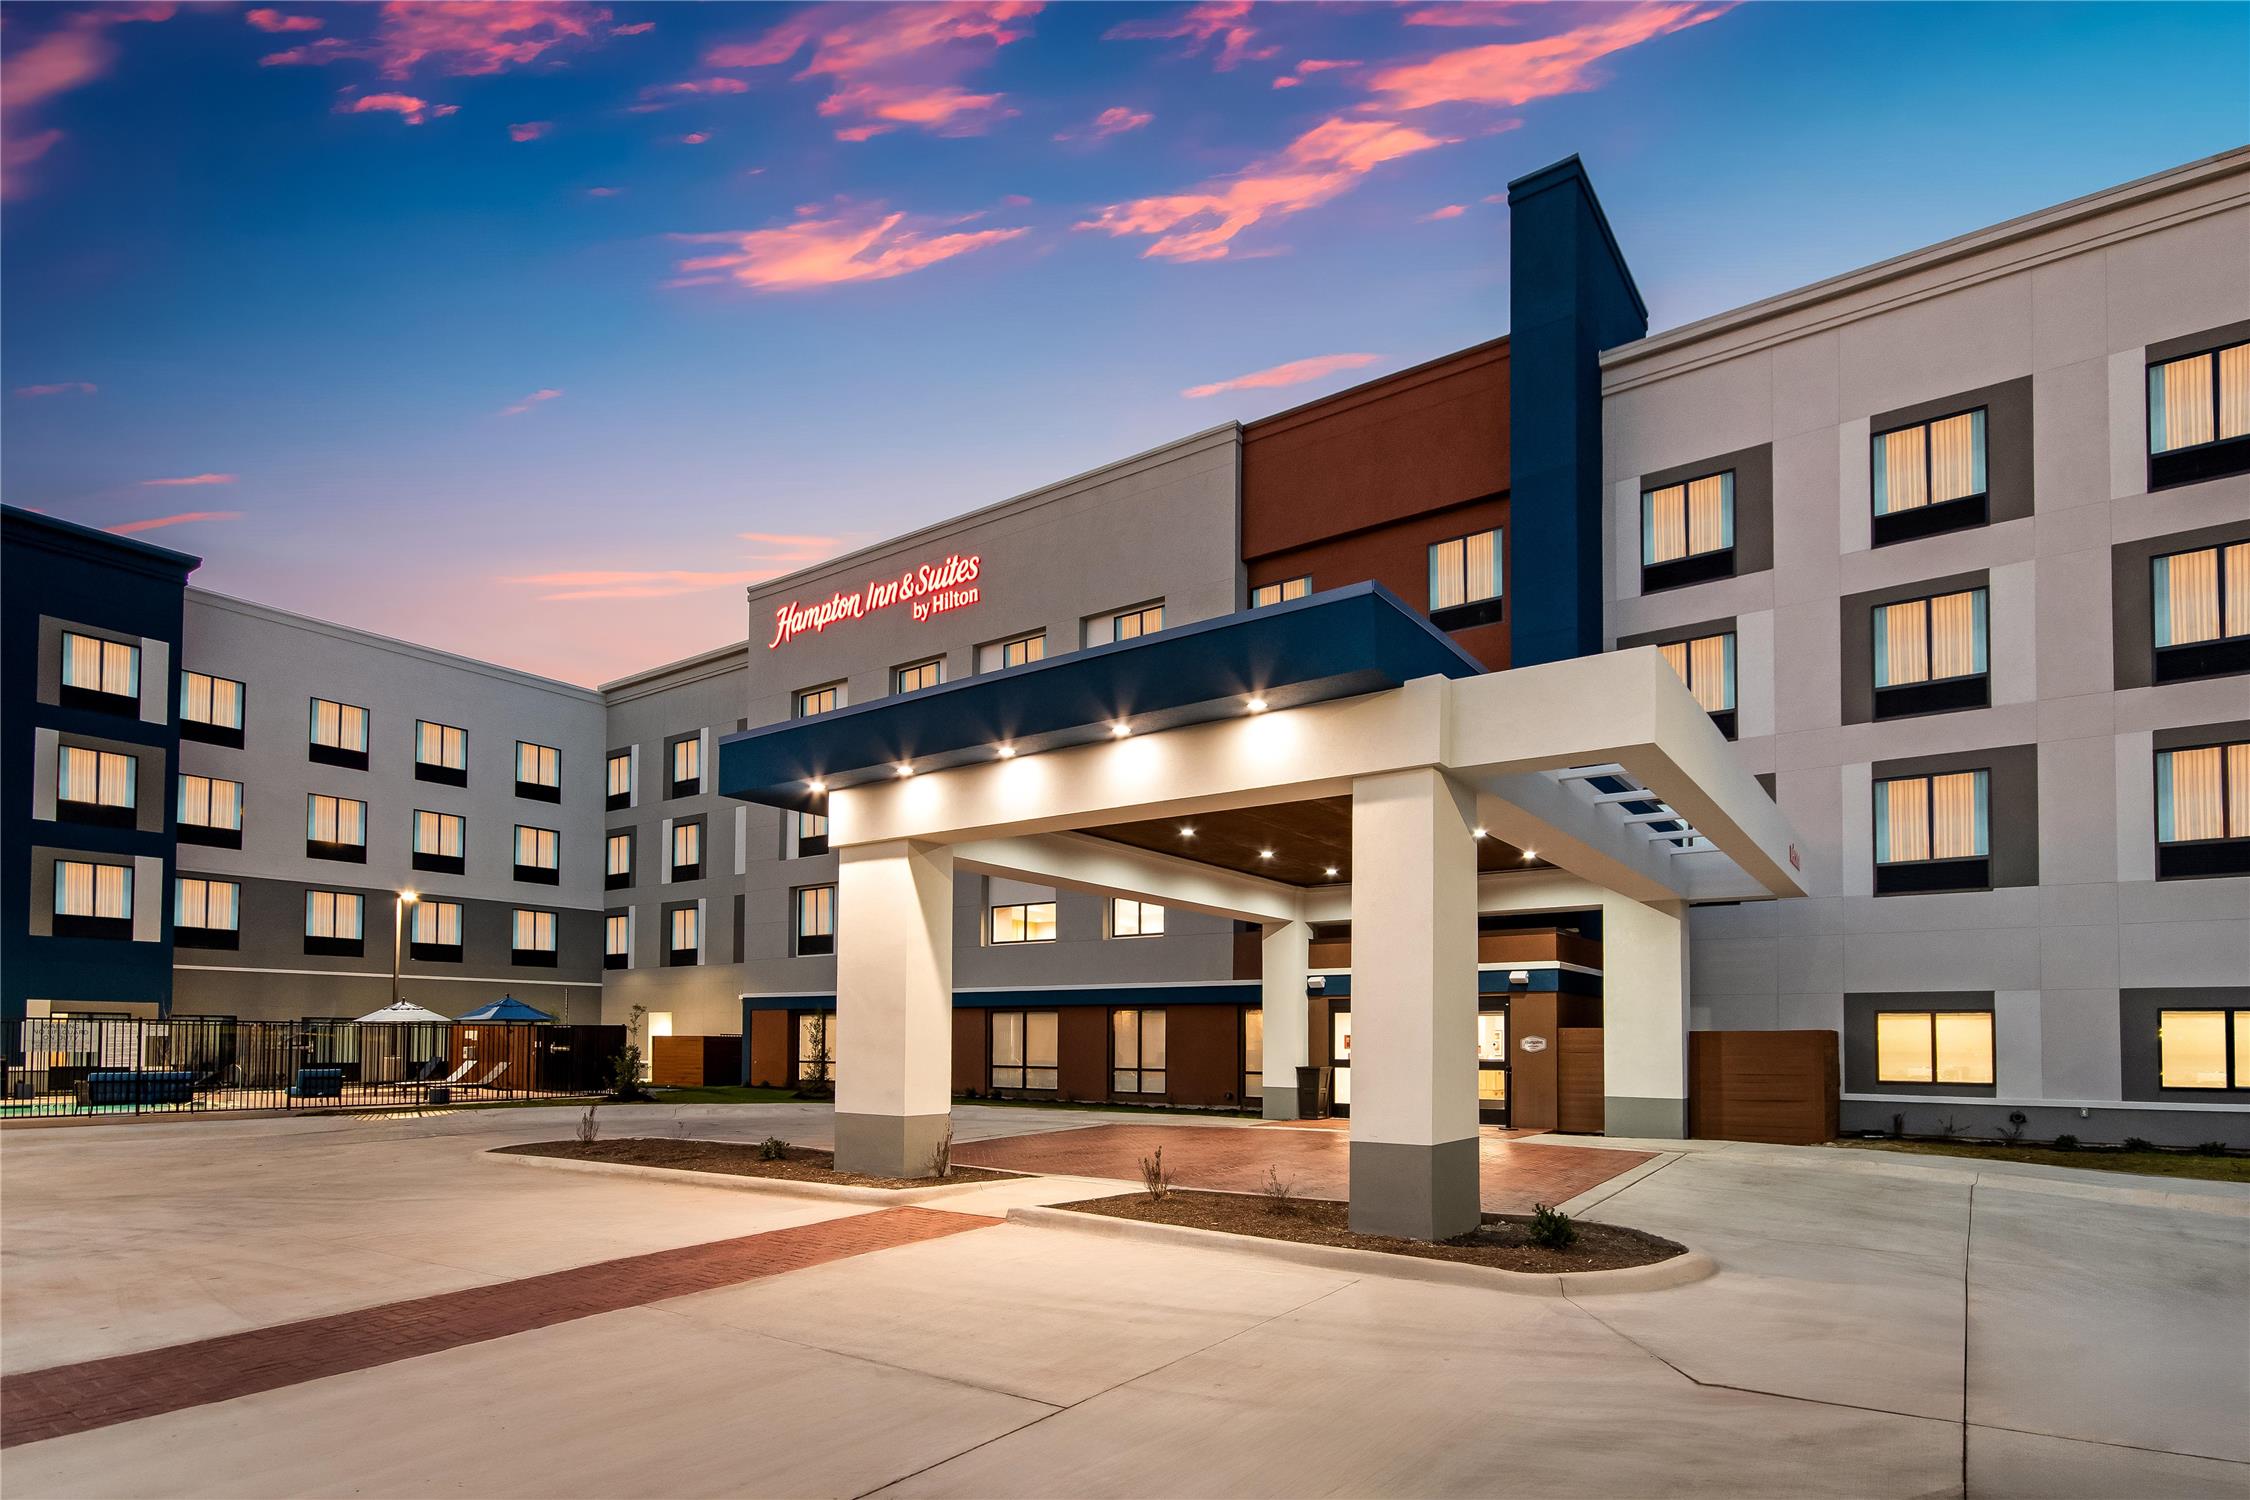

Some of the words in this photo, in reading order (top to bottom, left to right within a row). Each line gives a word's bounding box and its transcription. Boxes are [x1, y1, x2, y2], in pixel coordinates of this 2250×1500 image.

[769, 593, 864, 649] Hampton
[866, 582, 898, 611] Inn
[900, 573, 915, 600] &
[915, 555, 980, 595] Suites
[913, 602, 930, 621] by
[932, 588, 979, 613] Hilton
